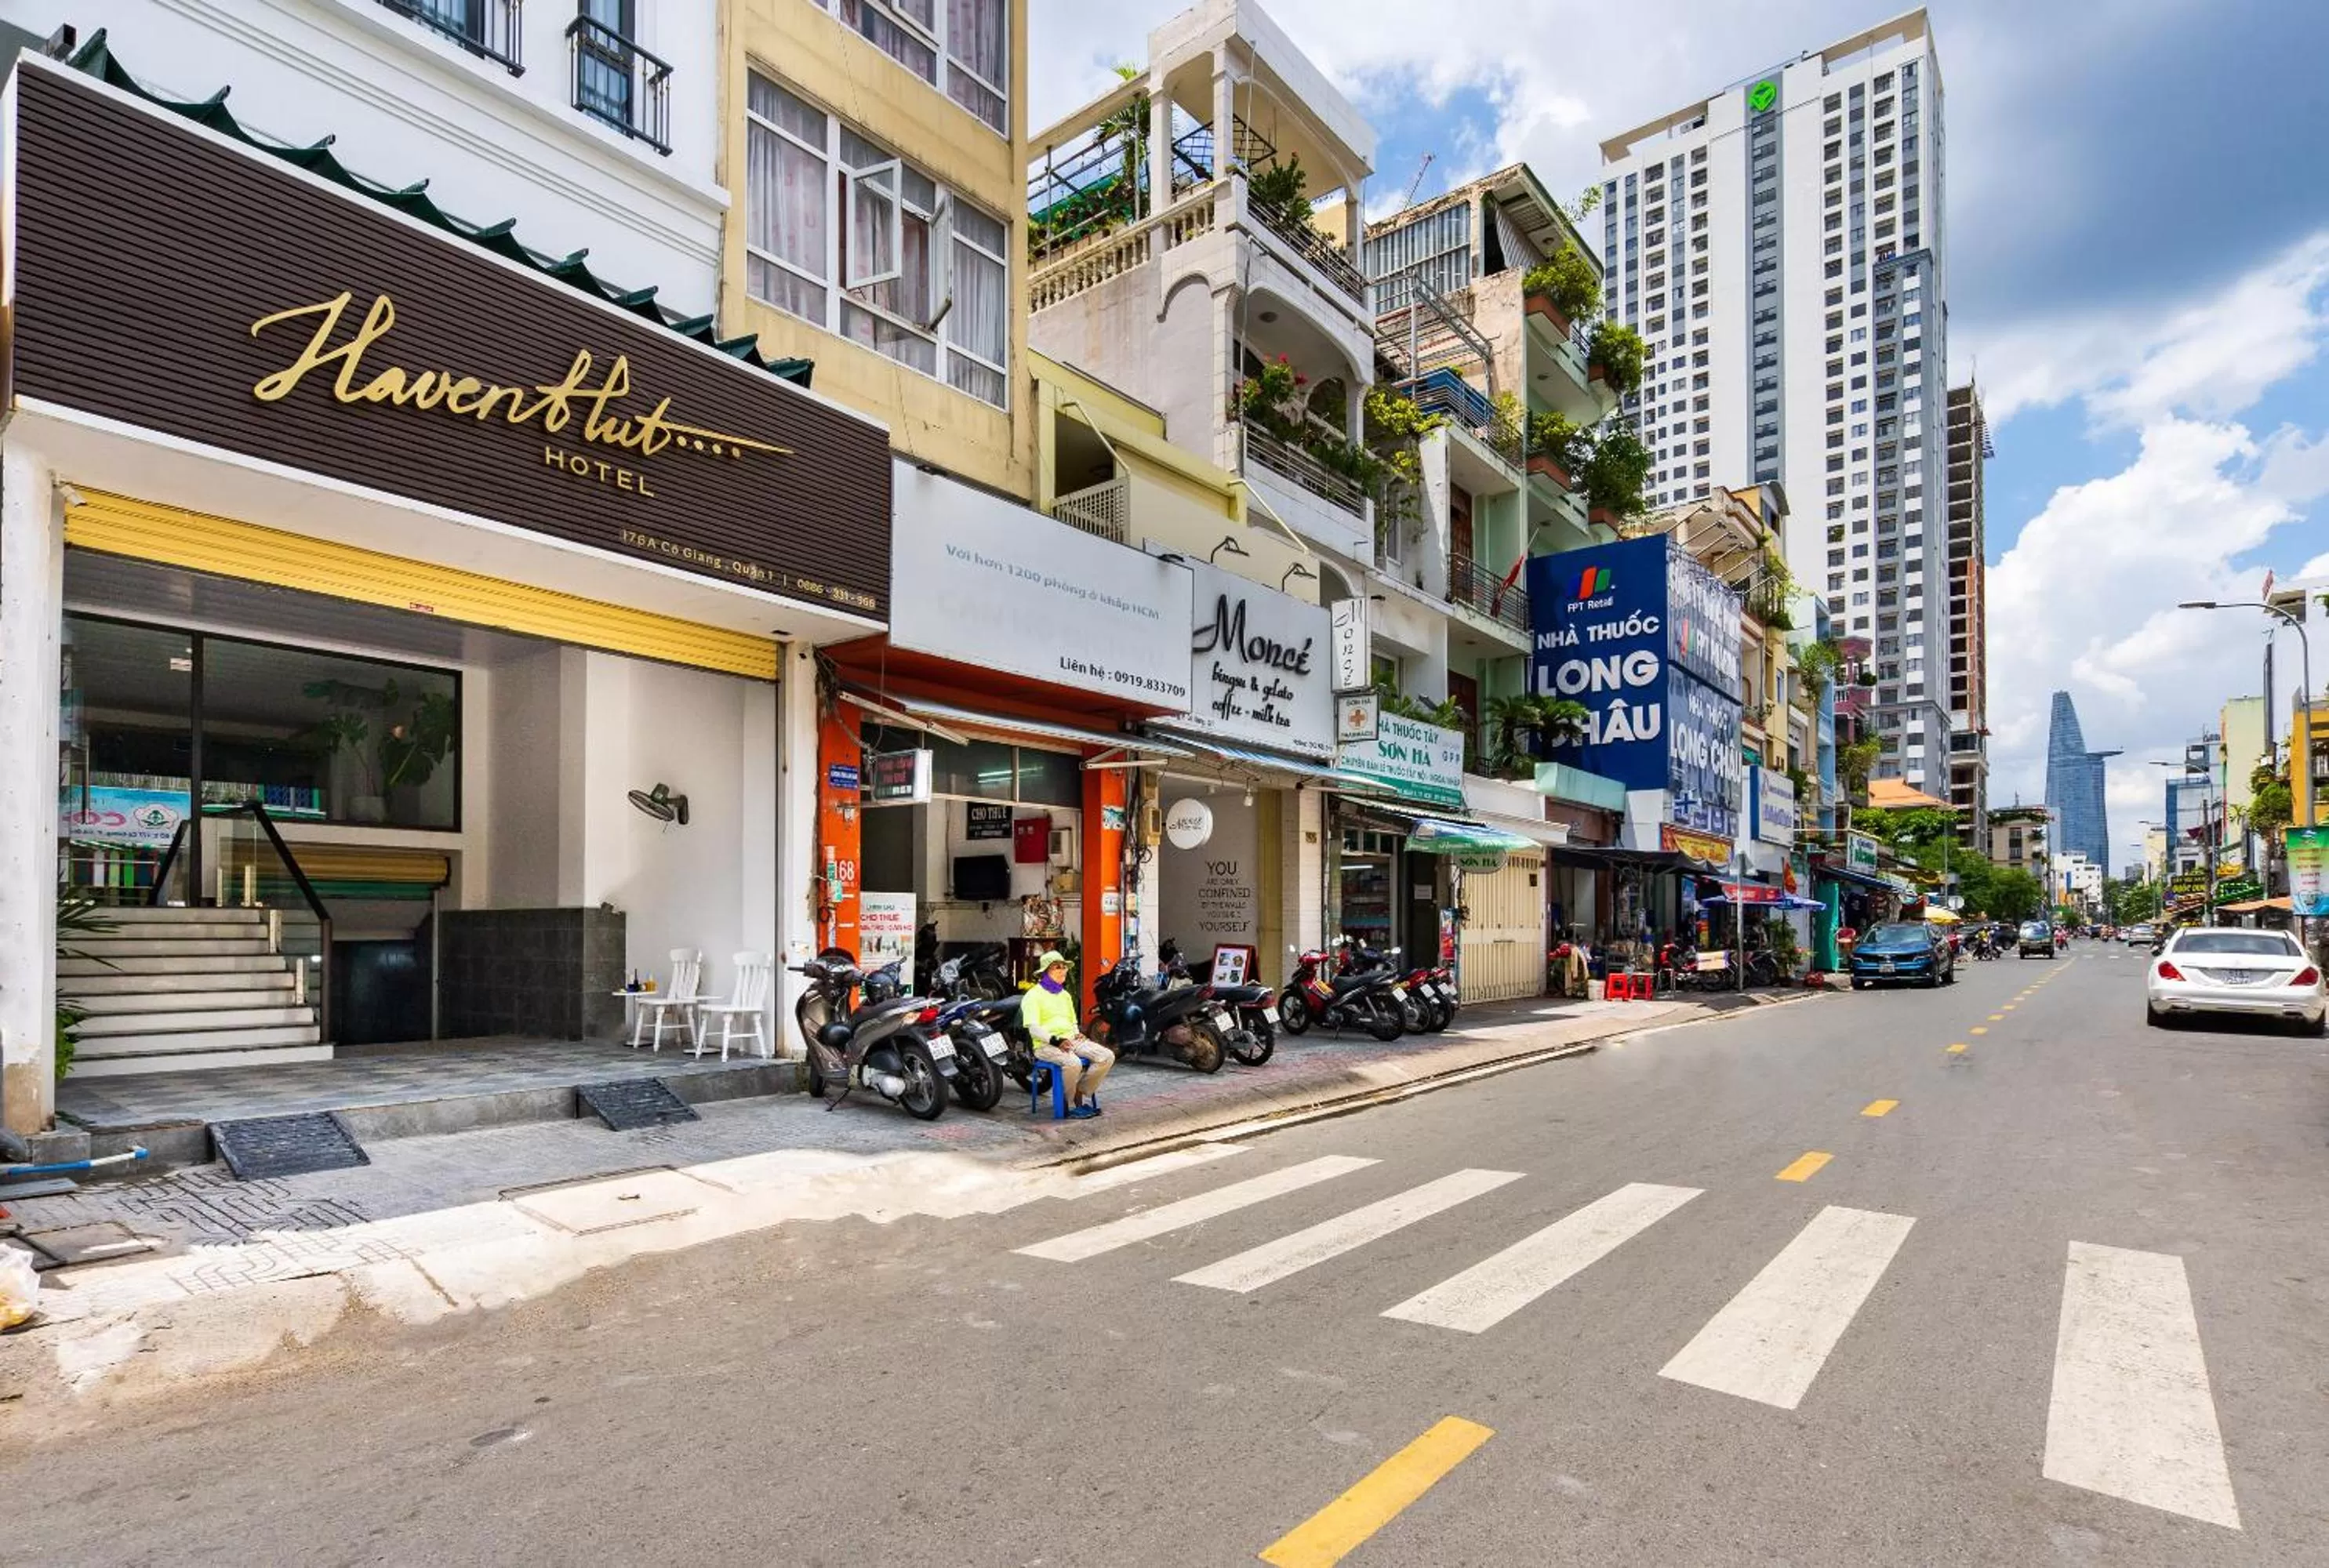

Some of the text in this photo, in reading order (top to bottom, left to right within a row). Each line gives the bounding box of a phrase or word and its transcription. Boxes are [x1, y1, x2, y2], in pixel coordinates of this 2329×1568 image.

[251, 291, 535, 425] Haven
[544, 445, 656, 499] HOTEL
[622, 529, 656, 549] 176A
[946, 543, 970, 561] Với
[975, 554, 1002, 571] hơn
[1008, 564, 1041, 583] 1200
[1568, 596, 1614, 613] FPT Retail
[1193, 593, 1313, 676] Moncé
[1537, 608, 1659, 650] NHÀ THUỐC
[1060, 656, 1086, 673] Liên
[1090, 664, 1105, 681] hệ
[1114, 670, 1186, 697] 0919.833709
[1212, 661, 1246, 692] bingsu
[1263, 678, 1294, 702] gelato
[1538, 649, 1659, 697] LONG
[1212, 693, 1243, 720] coffee
[1393, 722, 1421, 741] THUỐC
[1378, 739, 1407, 761] SƠN
[1412, 746, 1431, 766] HÀ
[1670, 718, 1742, 782] LONG CHÂU
[834, 861, 855, 881] 168
[1206, 862, 1237, 876] YOU
[1198, 888, 1251, 898] CONFINED
[1199, 920, 1251, 932] YOURSELF
